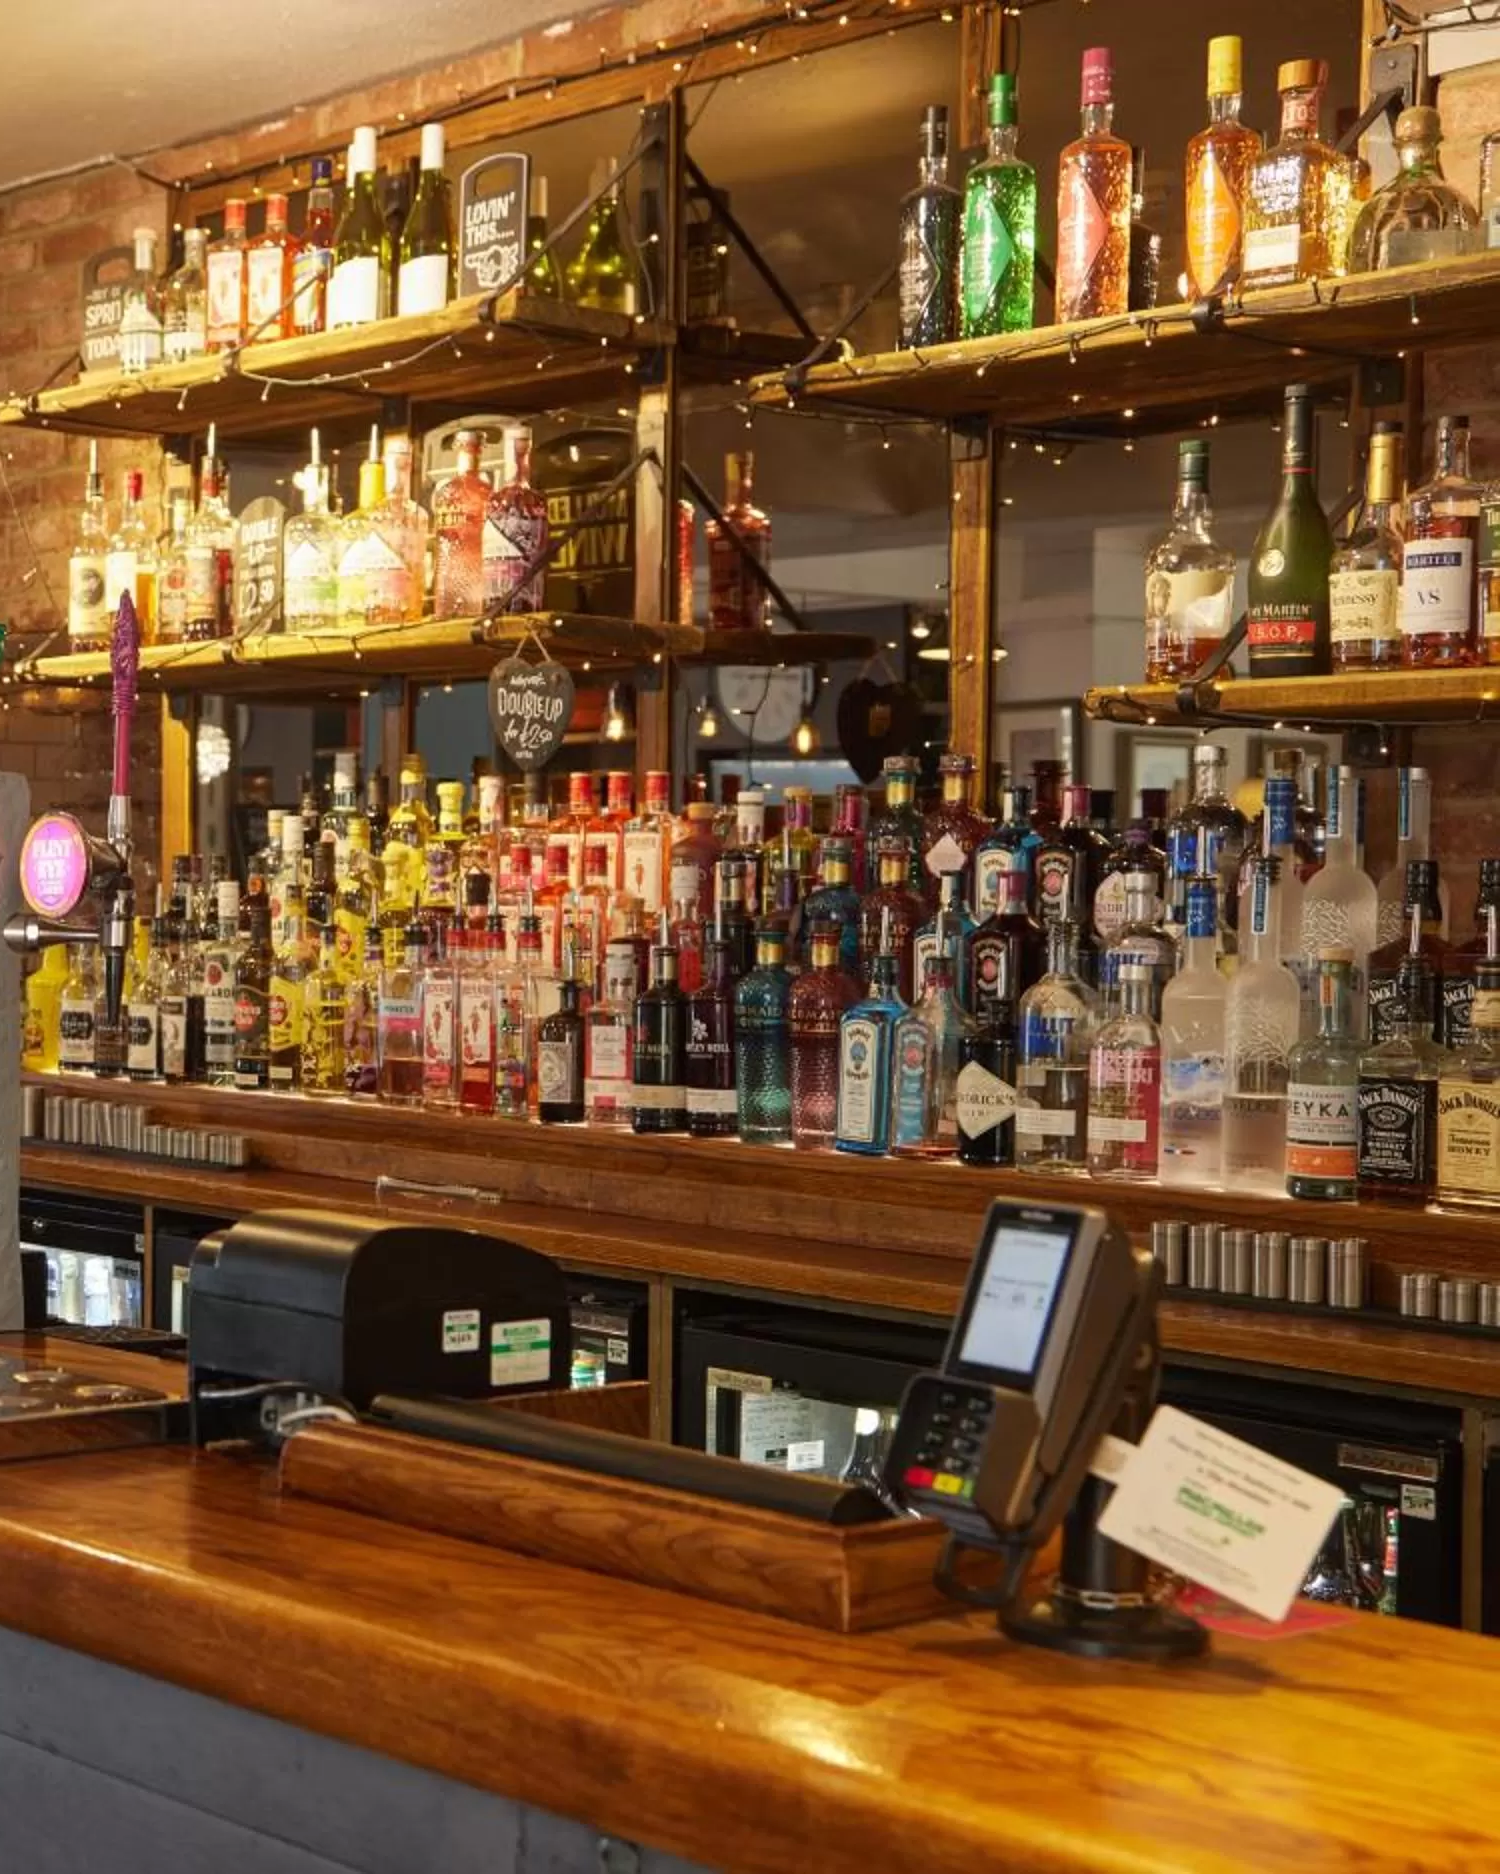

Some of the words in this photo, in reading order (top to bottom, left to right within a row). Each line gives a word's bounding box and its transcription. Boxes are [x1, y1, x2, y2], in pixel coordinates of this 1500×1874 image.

[466, 191, 515, 228] LOVIN'
[497, 687, 544, 719] DOUBLE
[544, 696, 563, 723] UP
[1291, 1101, 1349, 1117] EYKA
[1359, 1091, 1381, 1109] JACK
[1439, 1095, 1462, 1116] JACK
